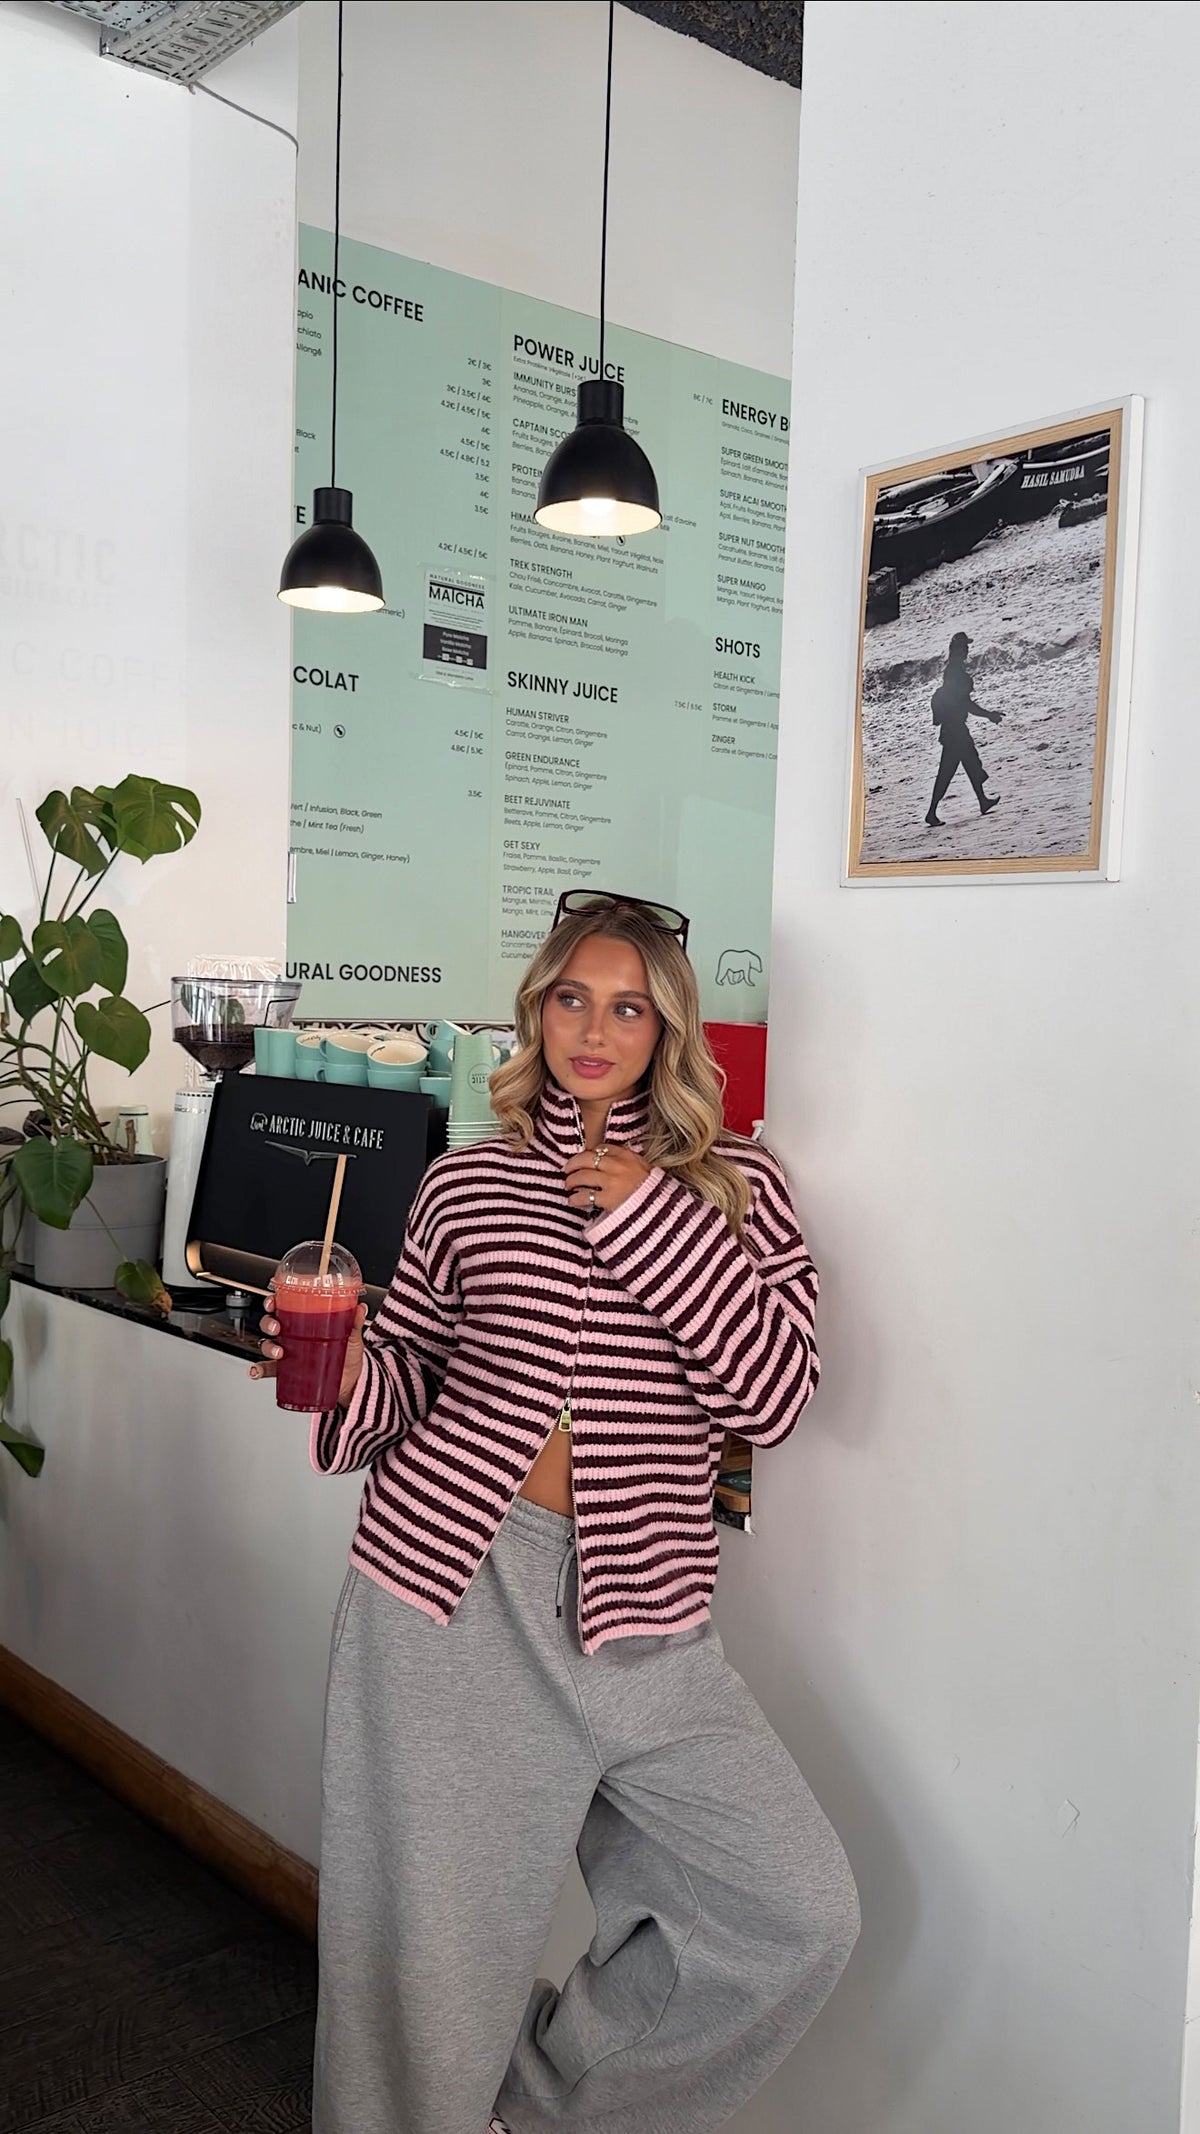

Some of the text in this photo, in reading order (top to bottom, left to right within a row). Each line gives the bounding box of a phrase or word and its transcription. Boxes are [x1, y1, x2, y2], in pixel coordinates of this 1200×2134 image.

[353, 286, 423, 322] COFFEE
[514, 335, 624, 382] POWER JUCE
[514, 372, 576, 397] IMMUNITY BURS
[722, 398, 776, 428] ENERGY
[513, 418, 548, 434] CAPTAIN
[721, 446, 741, 459] SUPER
[743, 452, 763, 464] GREEN
[1021, 473, 1048, 489] HASIL
[720, 489, 741, 502] SUPER
[719, 532, 739, 544] SUPER
[741, 537, 755, 547] NUT
[510, 558, 573, 579] TREK STRENGTH
[717, 574, 766, 592] SUPER MANGO
[428, 586, 484, 609] MATCHA
[508, 605, 588, 628] ULTIMATE IRON MAN
[715, 637, 760, 658] SHOTS
[294, 666, 359, 692] COLAT
[714, 670, 755, 684] HEALTH KICK
[507, 671, 618, 703] SKINNY JUICE
[506, 707, 569, 723] HUMAN STRIVER
[713, 702, 737, 713] STORM
[711, 734, 736, 745] ZINGER
[505, 751, 580, 768] GREEN ENDURANCE
[504, 794, 571, 809] BEET REJUVINATE
[361, 810, 382, 818] Green
[503, 840, 541, 851] GET SEXY
[503, 885, 554, 896] TROPIC TRAIL
[285, 962, 442, 983] URAL GOODNESS
[269, 1114, 384, 1150] ARCTIC JUICE & CAFE
